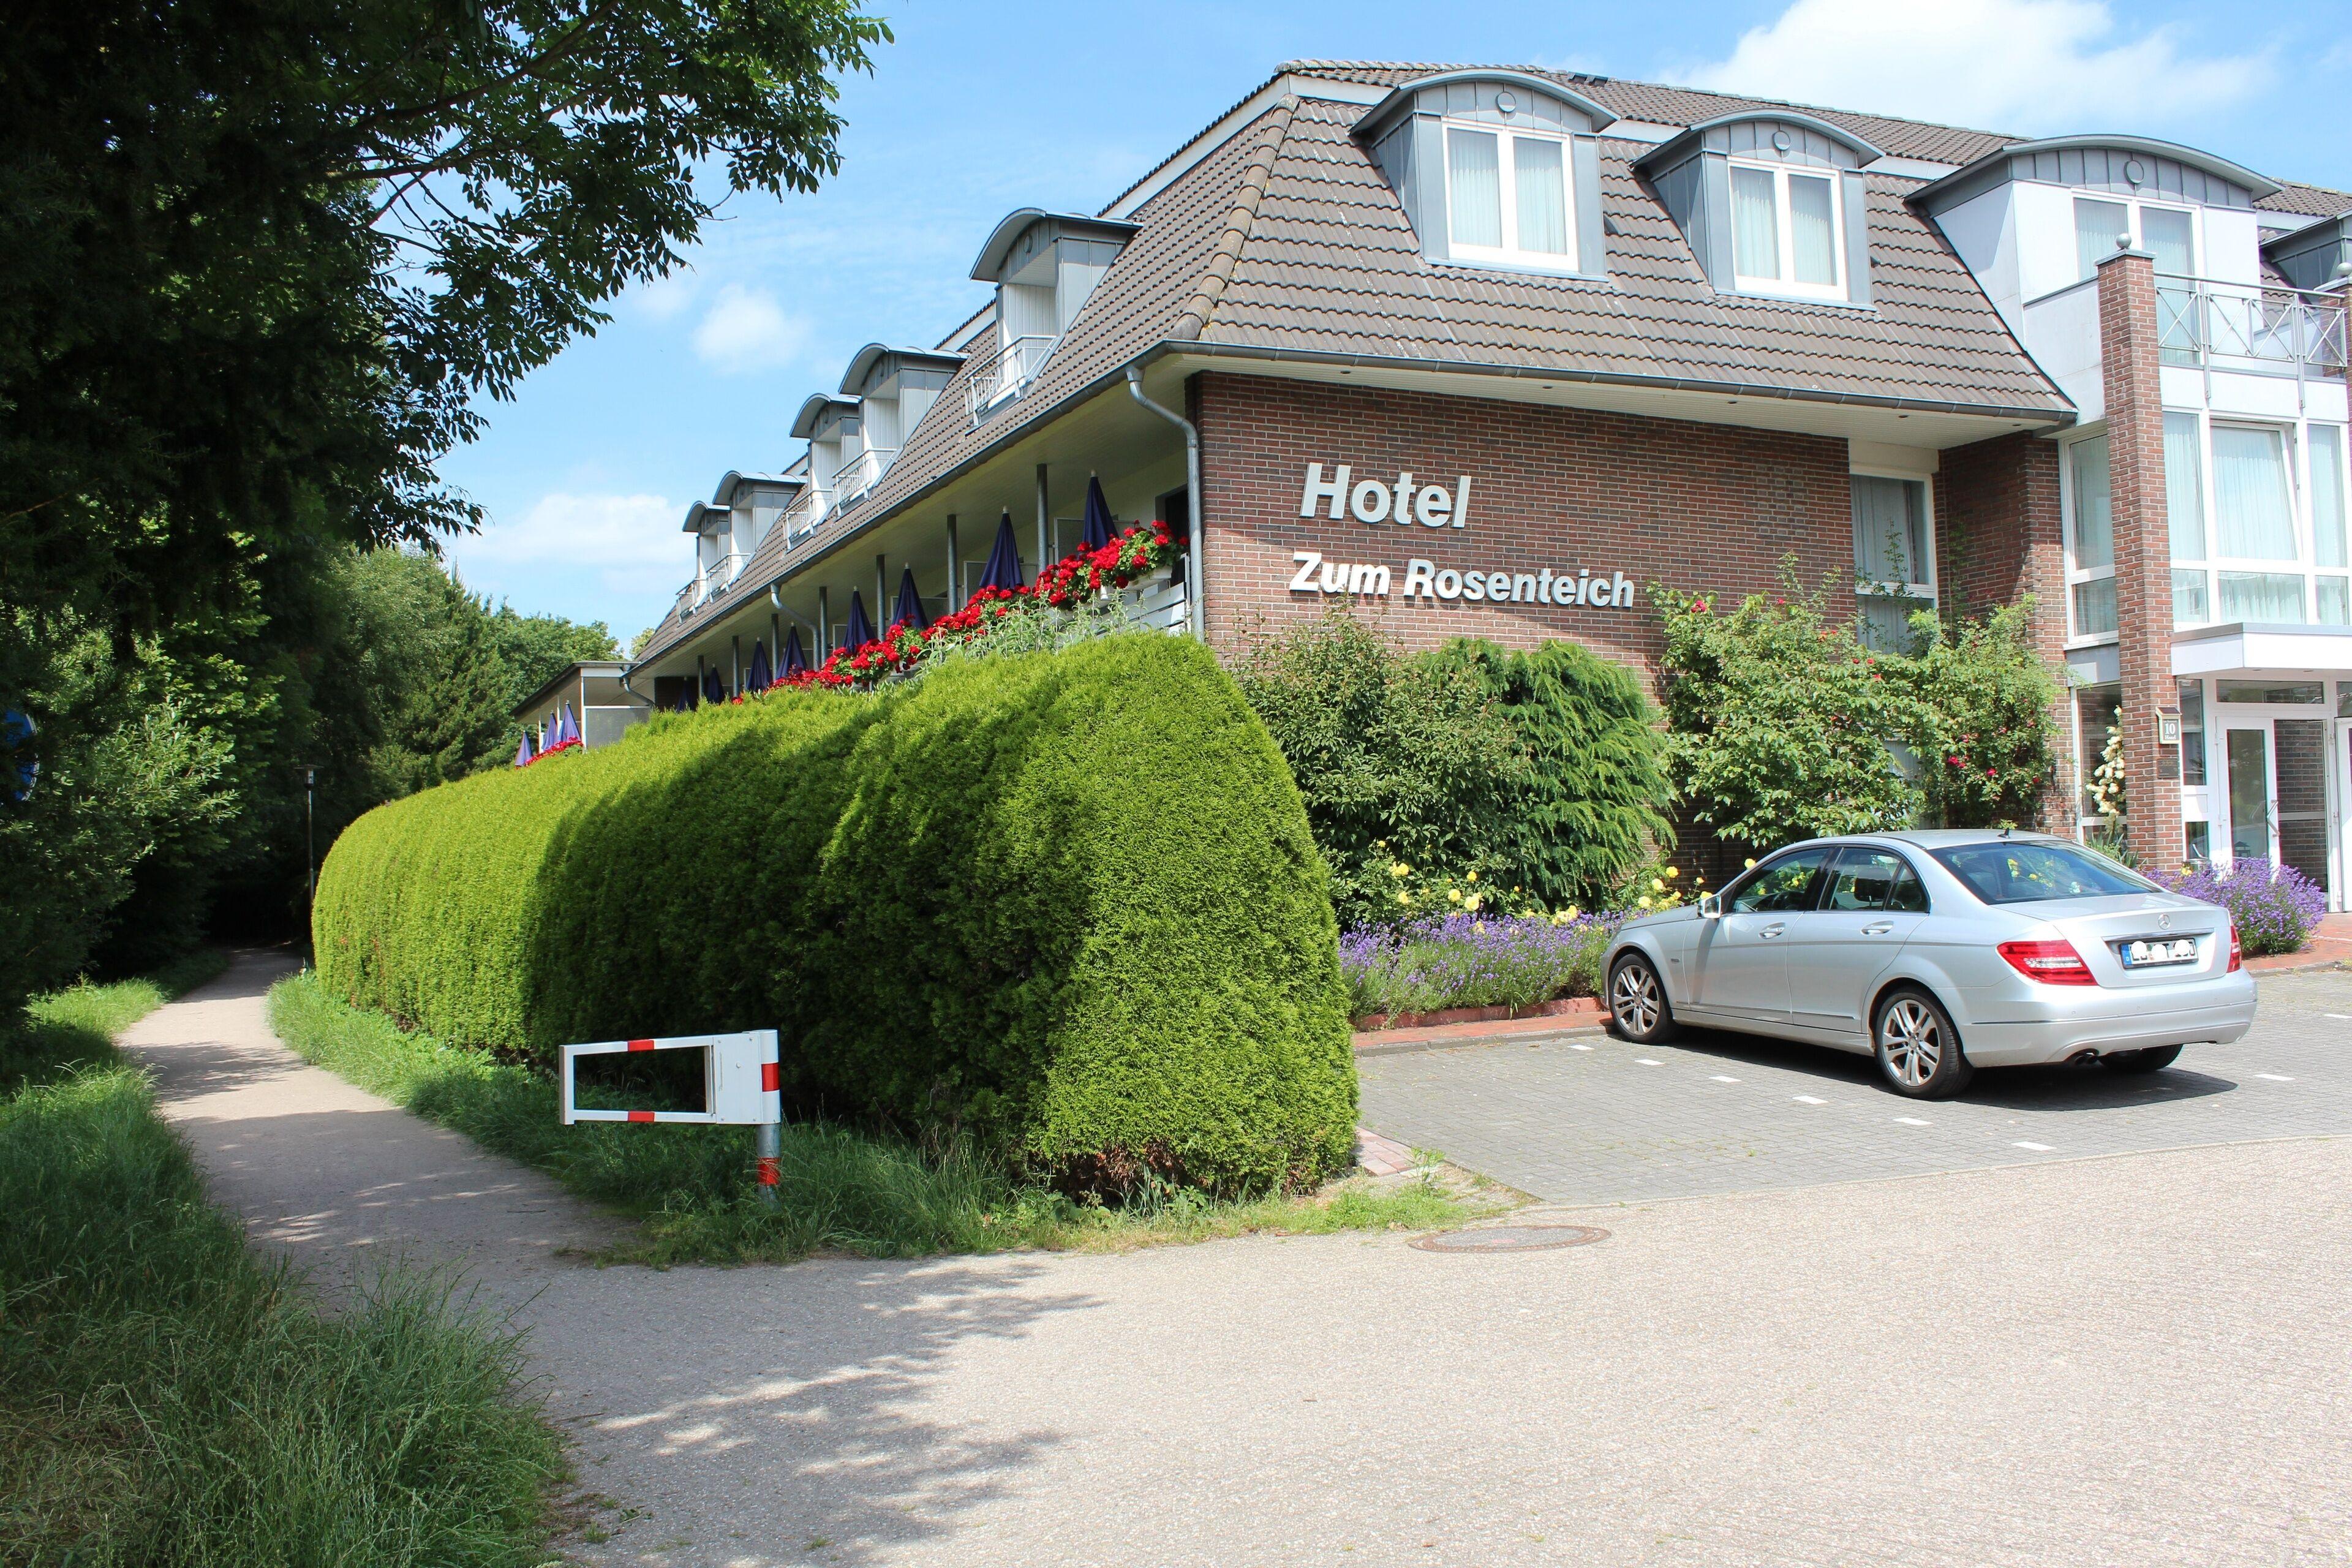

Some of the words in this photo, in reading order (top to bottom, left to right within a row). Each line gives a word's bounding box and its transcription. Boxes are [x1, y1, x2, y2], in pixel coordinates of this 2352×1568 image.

[1299, 462, 1471, 529] Hotel
[1289, 551, 1391, 595] Zum
[1404, 559, 1634, 608] Rosenteich
[2165, 723, 2176, 734] 10
